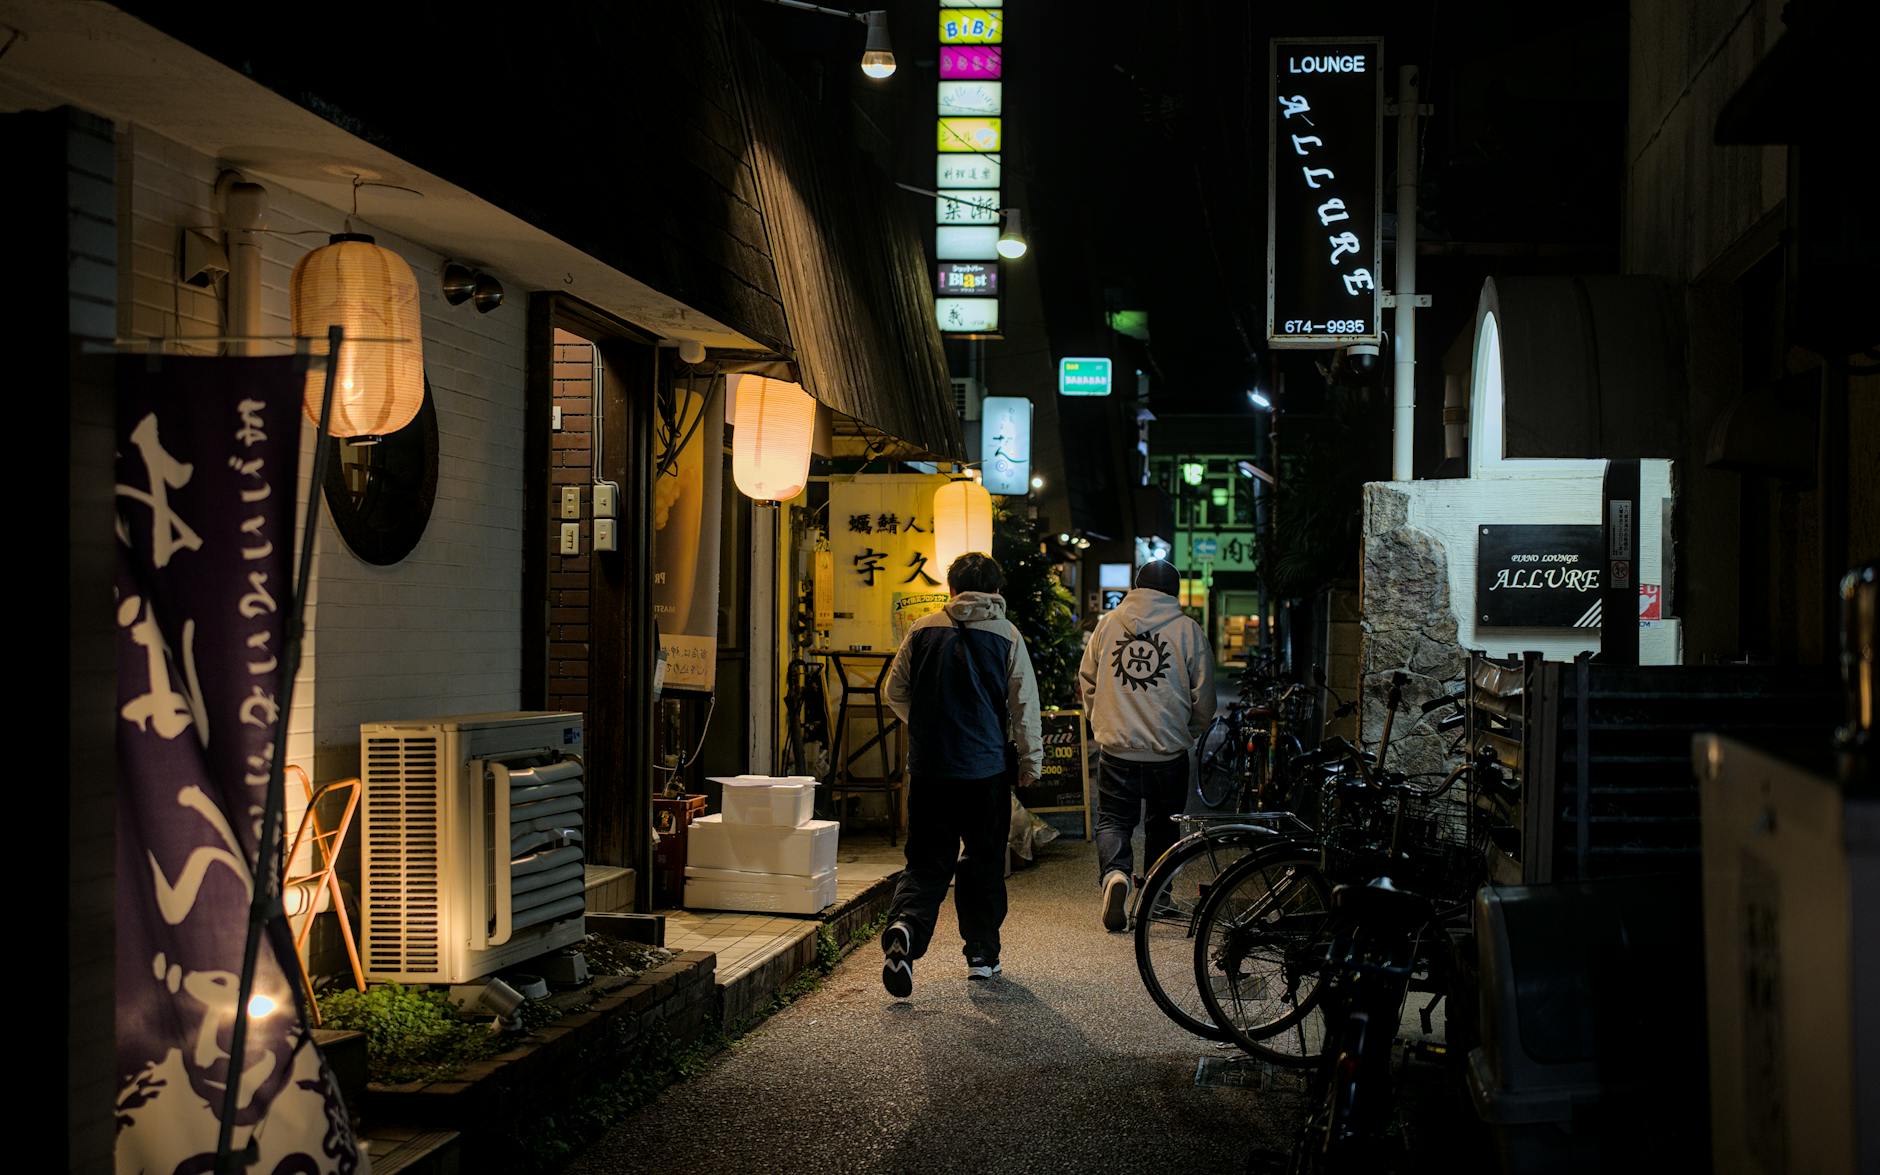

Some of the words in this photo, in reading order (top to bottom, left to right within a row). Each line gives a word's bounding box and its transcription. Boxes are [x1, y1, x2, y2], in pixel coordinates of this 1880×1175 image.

[1289, 55, 1366, 74] LOUNGE
[1278, 94, 1375, 296] ALLURE
[948, 272, 987, 288] Blast
[1285, 320, 1365, 333] 674-9935
[853, 547, 942, 587] 宇久
[1511, 554, 1539, 563] PIANO
[1541, 554, 1579, 563] LOUNGE
[1489, 566, 1601, 592] ALLURE
